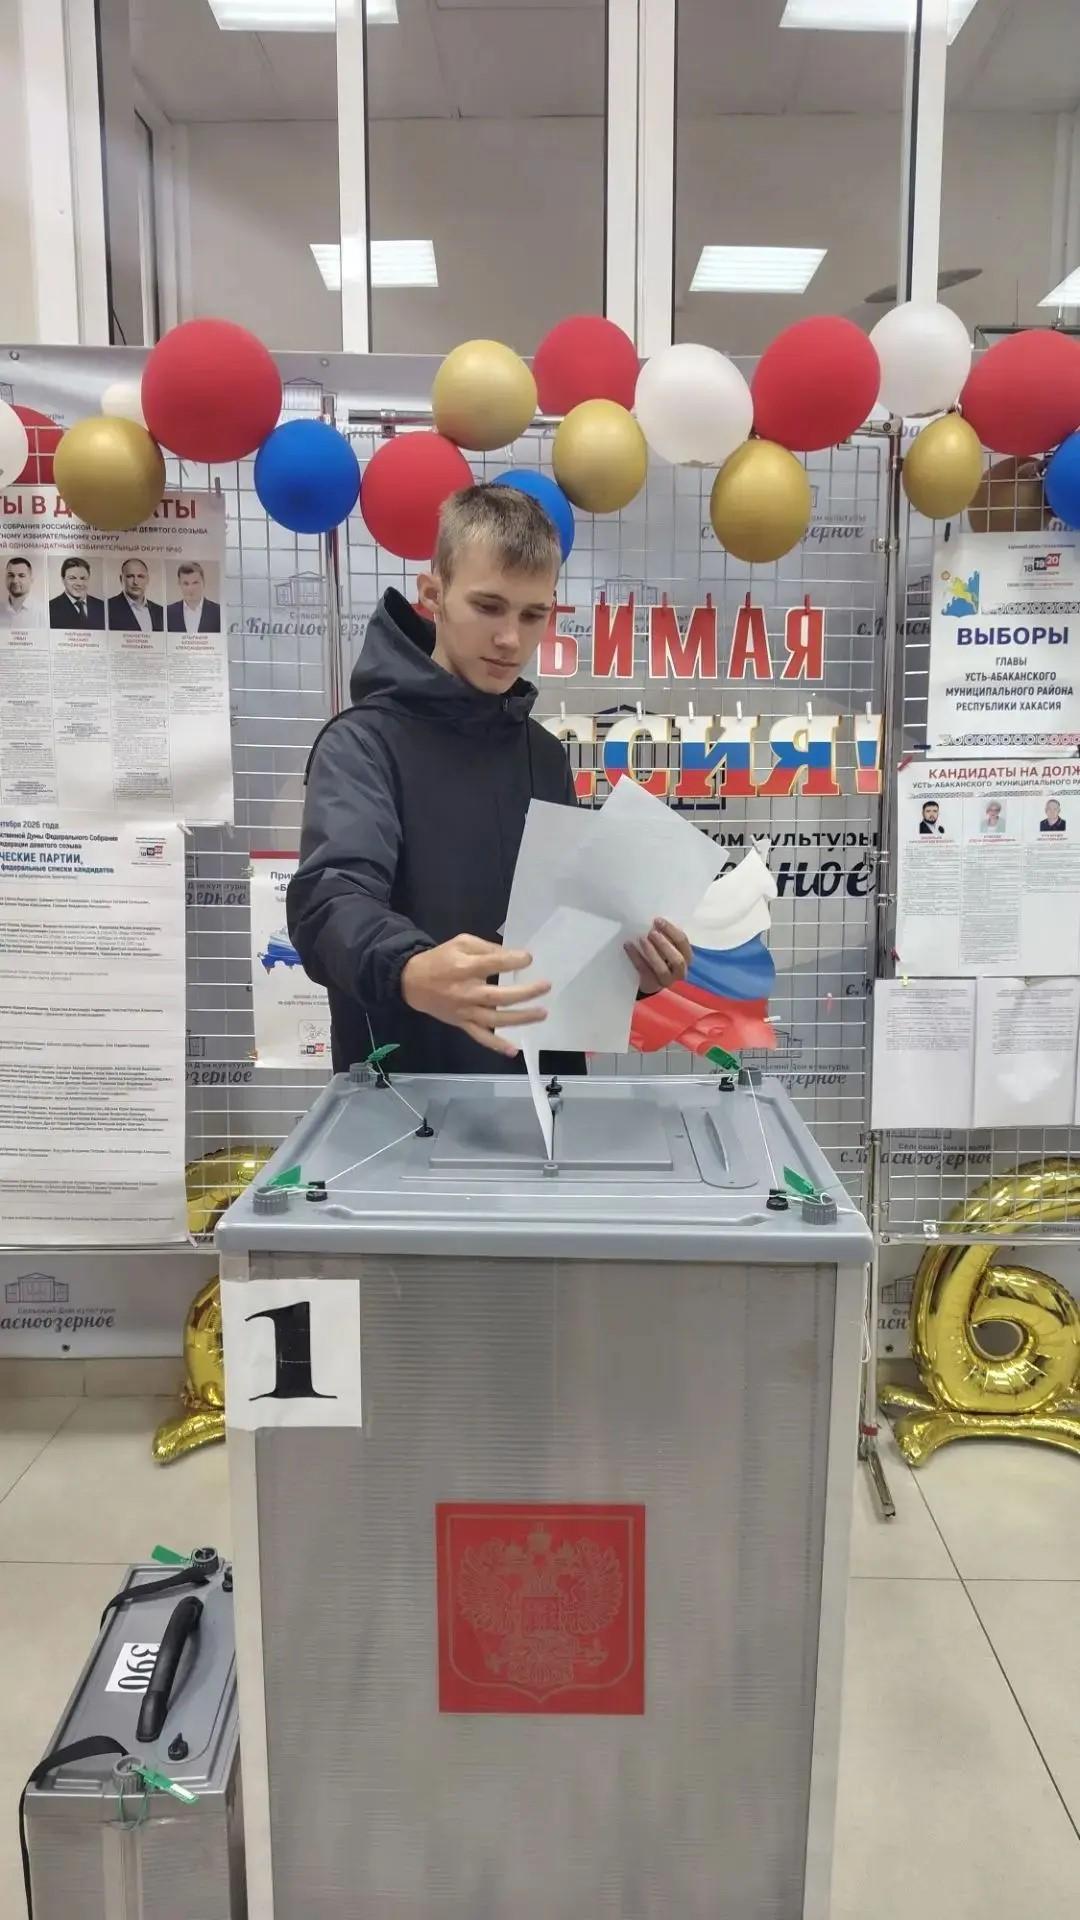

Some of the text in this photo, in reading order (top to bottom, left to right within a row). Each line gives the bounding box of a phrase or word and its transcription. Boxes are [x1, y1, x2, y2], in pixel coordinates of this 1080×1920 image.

[32, 495, 47, 514] В
[0, 532, 21, 540] НОМУ
[957, 626, 1069, 646] ВЫБОРЫ
[995, 656, 1028, 667] ГЛАВЫ
[965, 671, 1057, 682] УСТЬ-АБАКАНСКОГО
[945, 684, 1074, 698] МУНИЦИПАЛЬНОГО РАЙОНА
[955, 700, 1062, 712] РЕСПУБЛИКИ ХАКАСИЯ
[928, 766, 1017, 780] КАНДИДАТЫ
[1020, 765, 1038, 777] НА
[912, 780, 993, 789] УСТЬ-АБАКАНСКОГО
[995, 778, 1072, 788] МУНИЦИПАЛЬНОГО
[22, 820, 41, 829] 2026
[42, 822, 60, 830] года
[27, 832, 44, 841] Думы
[89, 834, 119, 843] Собрания
[700, 829, 744, 847] ом
[39, 852, 84, 866] ПАРТИИ,
[48, 866, 73, 874] списки
[74, 866, 115, 875] кандидатов
[245, 1301, 337, 1401] 1
